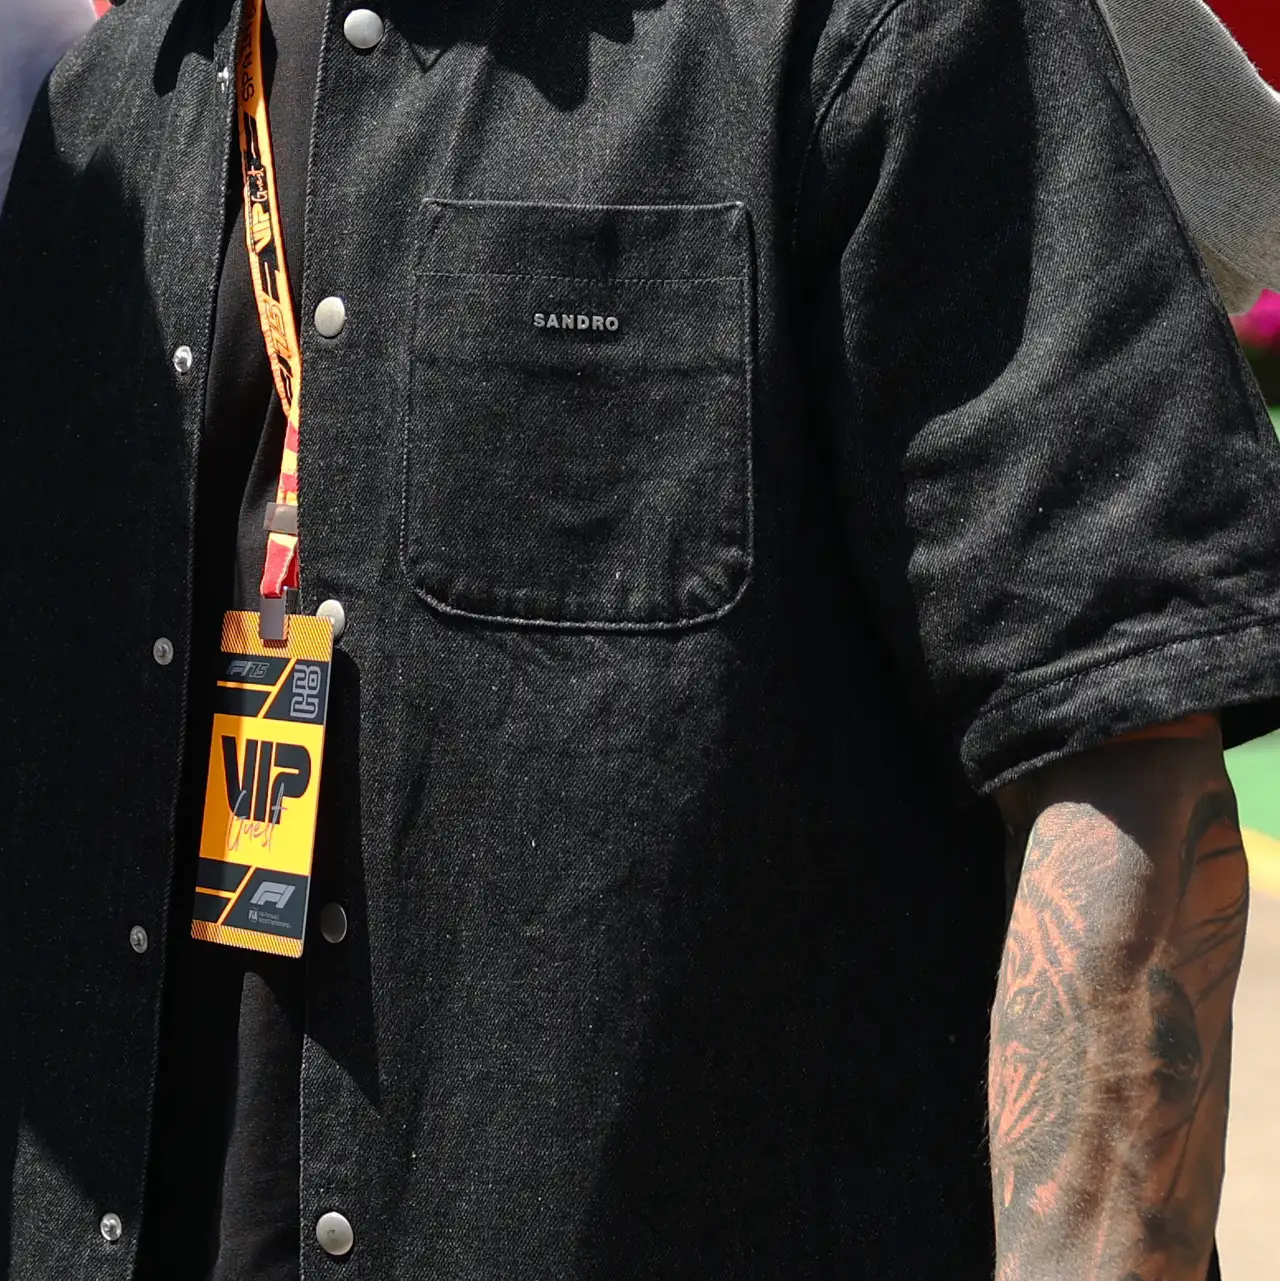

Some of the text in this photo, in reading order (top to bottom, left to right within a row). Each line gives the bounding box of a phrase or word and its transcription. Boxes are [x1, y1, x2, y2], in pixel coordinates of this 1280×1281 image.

[252, 202, 272, 255] VIP
[533, 313, 619, 331] SANDRO
[221, 734, 312, 826] VIP
[226, 782, 287, 852] Guest
[250, 881, 296, 909] F1
